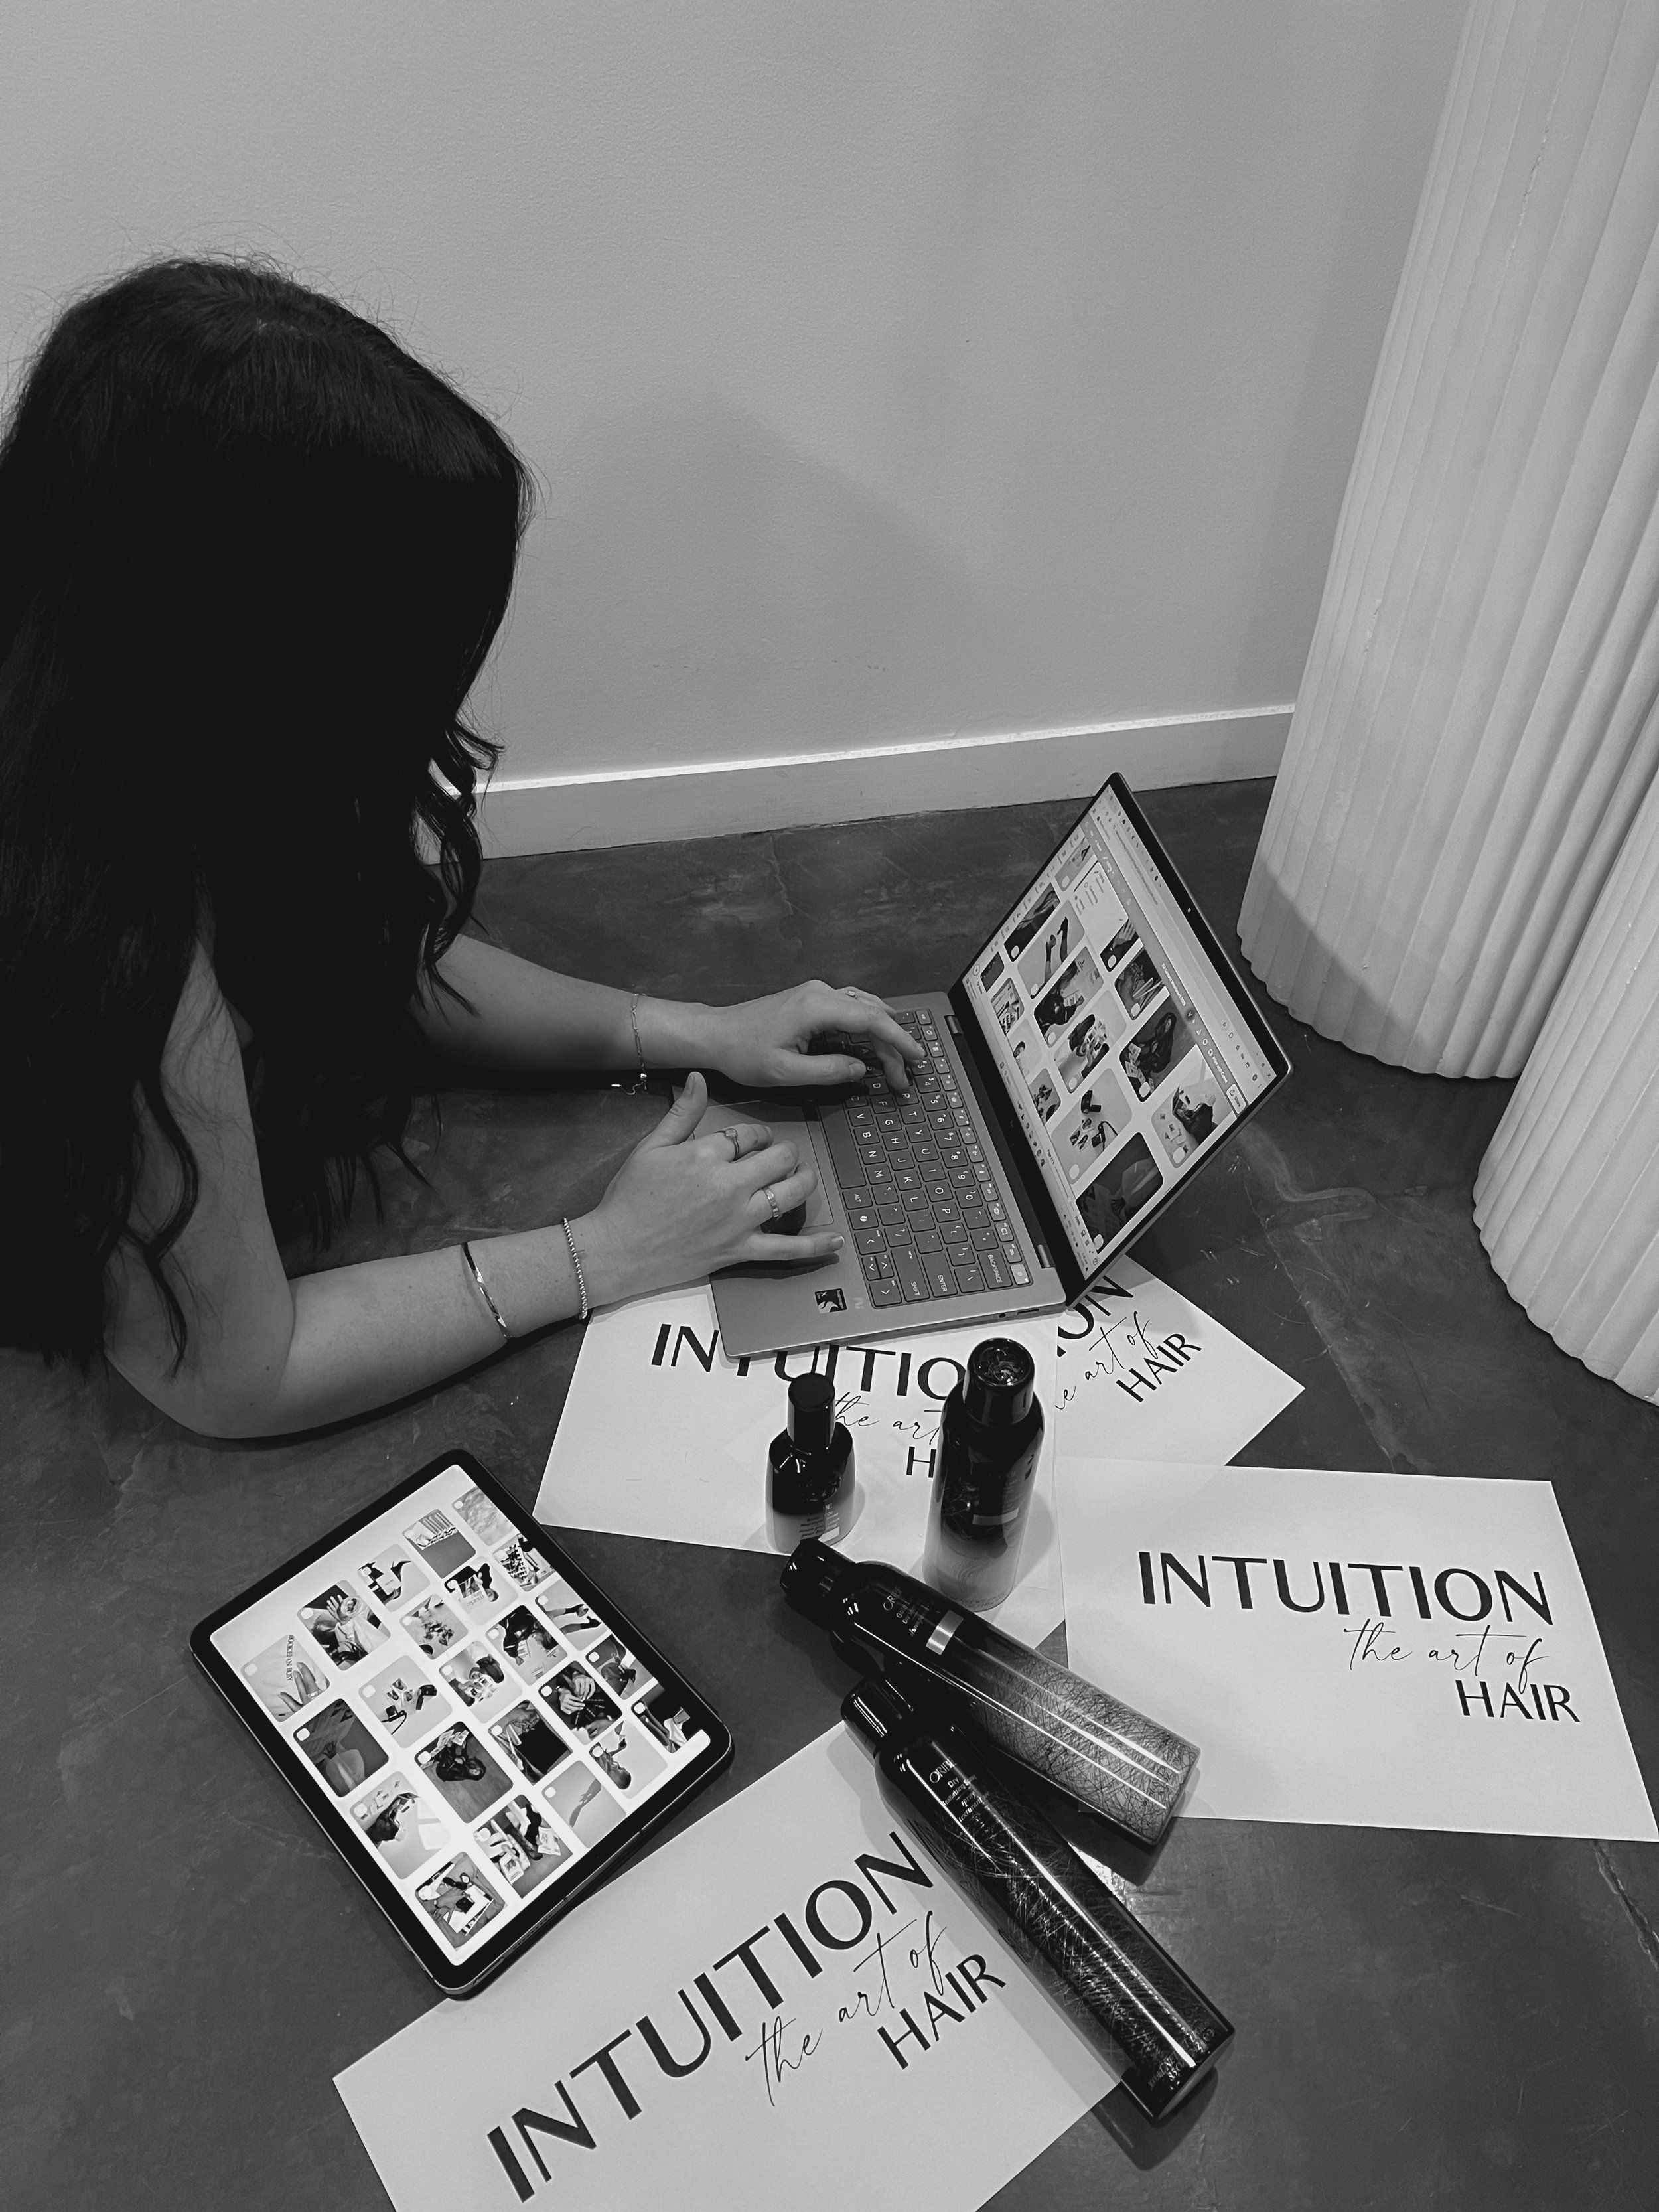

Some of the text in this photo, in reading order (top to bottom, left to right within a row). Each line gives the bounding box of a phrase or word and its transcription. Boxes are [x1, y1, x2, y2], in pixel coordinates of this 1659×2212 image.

[938, 1274, 948, 1292] ENTER
[987, 1254, 1003, 1283] BACKSPACE
[910, 1281, 920, 1296] SHIFT
[1085, 1317, 1127, 1380] art
[1127, 1311, 1158, 1359] of
[1115, 1333, 1202, 1403] HAIR
[1138, 1551, 1553, 1626] INTUITION
[896, 1605, 908, 1618] Gold
[1343, 1618, 1550, 1694] the art of
[1455, 1679, 1581, 1723] HAIR
[929, 1756, 956, 1783] ORIBE
[947, 1777, 959, 1788] Dry
[942, 1775, 977, 1806] Texturizing Spray
[961, 1791, 975, 1807] spray
[487, 1830, 934, 2204] INTUITION
[745, 1910, 948, 2107] the art of
[876, 1954, 1007, 2070] HAIR
